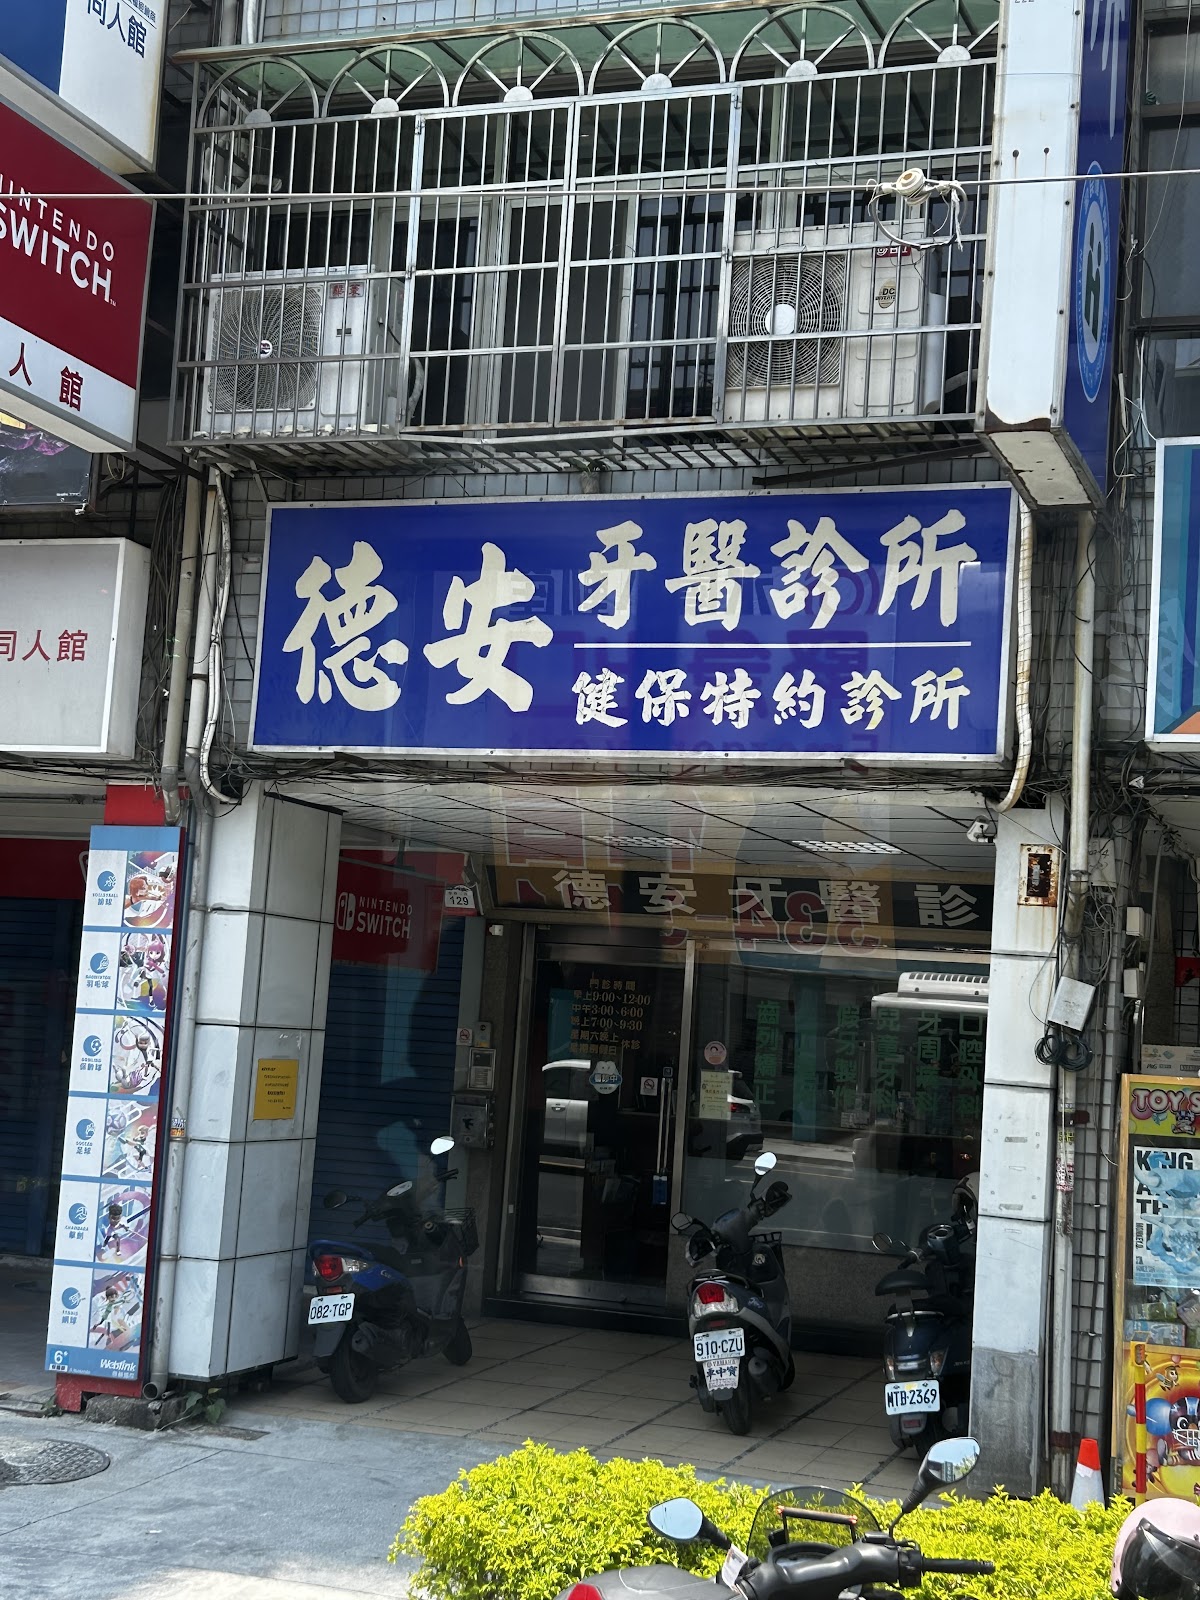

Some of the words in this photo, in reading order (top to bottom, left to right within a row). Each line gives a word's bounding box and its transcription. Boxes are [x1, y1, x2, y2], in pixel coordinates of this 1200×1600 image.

[0, 173, 115, 262] INTENDO
[8, 342, 84, 412] 人館
[282, 541, 553, 712] 德安
[577, 508, 978, 631] 牙醫診所
[571, 666, 971, 731] 健保特約診所
[359, 896, 413, 916] NINTENDO
[449, 895, 469, 906] 129
[356, 912, 412, 940] SWITCH
[86, 980, 109, 989] 羽毛球
[100, 1358, 137, 1372] Weblink
